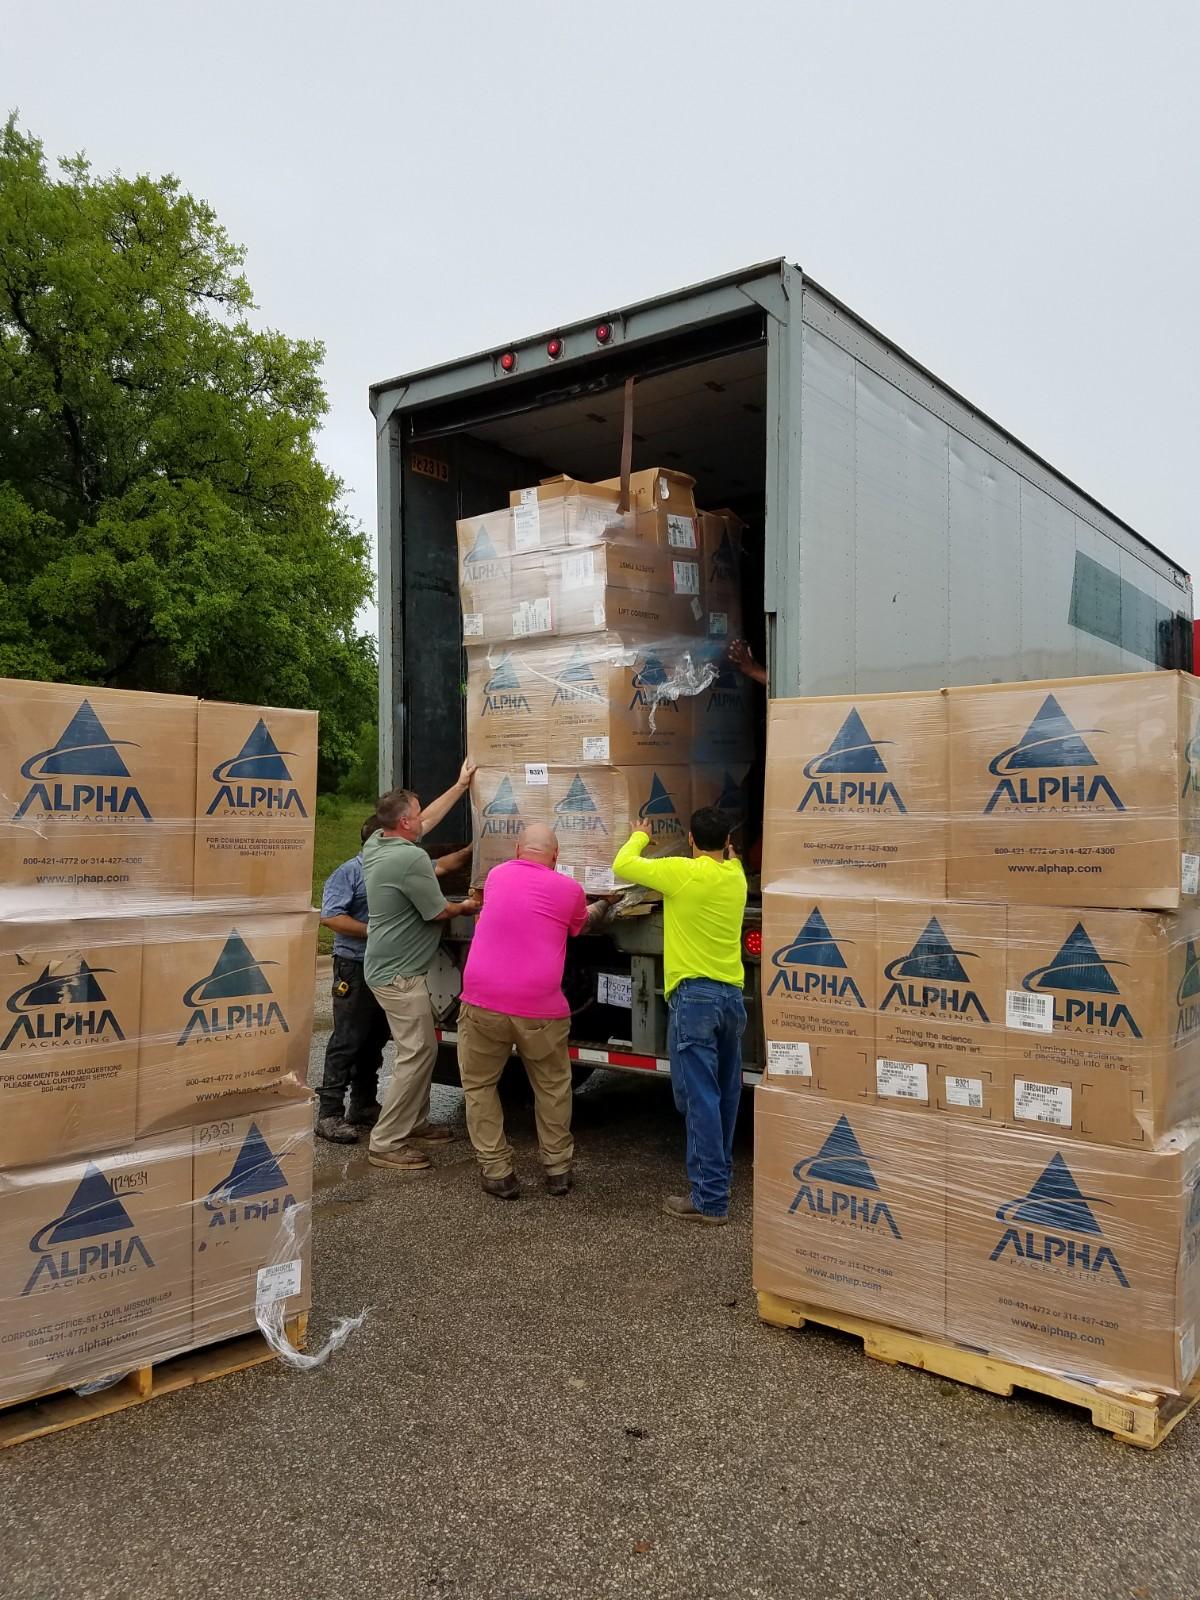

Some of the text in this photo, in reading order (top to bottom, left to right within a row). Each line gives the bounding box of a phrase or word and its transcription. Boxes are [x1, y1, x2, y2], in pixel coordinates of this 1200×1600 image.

[481, 694, 531, 716] ALPHA
[11, 784, 154, 822] ALPHA
[206, 785, 308, 818] ALPHA
[796, 782, 909, 814] ALPHA
[982, 775, 1127, 814] ALPHA
[36, 813, 136, 823] PACKAGING
[224, 809, 295, 817] PACKAGING
[813, 806, 892, 814] PACKAGING
[1004, 805, 1107, 814] PACKAGING
[650, 818, 685, 836] LPHA
[23, 857, 78, 865] 800-421-4772
[1008, 864, 1102, 874] www.alphap.com
[36, 873, 129, 885] www.alphap.com
[767, 970, 867, 1008] ALPHA
[781, 993, 852, 1006] PACKAGING
[879, 982, 991, 1023] ALPHA
[780, 1011, 849, 1027] Turning the science
[894, 1006, 975, 1022] PACKAGING
[1053, 996, 1143, 1039] LPHA
[0, 1009, 126, 1051] ALPHA
[176, 1001, 289, 1046] ALPHA
[772, 1018, 780, 1026] of
[781, 1020, 816, 1032] packaging
[818, 1024, 832, 1033] into
[1053, 1024, 1126, 1038] CKAGING
[20, 1036, 110, 1049] PACKAGING
[196, 1028, 276, 1044] PACKAGING
[895, 1027, 972, 1044] Turning the science
[938, 1040, 953, 1050] into
[1034, 1043, 1067, 1057] Turning
[1070, 1047, 1084, 1058] the
[1024, 1051, 1032, 1059] of
[1035, 1052, 1080, 1067] packaging
[1083, 1058, 1100, 1068] into
[3, 1080, 32, 1089] PLEASE
[33, 1078, 51, 1087] CALL
[52, 1074, 91, 1085] CUSTOMER
[16, 1071, 59, 1080] COMMENTS
[60, 1069, 75, 1077] AND
[186, 1073, 233, 1086] 800-421-4772
[955, 1078, 970, 1088] B321
[787, 1185, 903, 1240] ALPHA
[21, 1235, 155, 1296] ALPHA
[988, 1228, 1131, 1289] ALPHA
[42, 1265, 137, 1291] PACKAGING
[805, 1265, 882, 1291] www.alphap.com
[1, 1325, 53, 1344] CORPORATE
[1011, 1317, 1105, 1346] www.alphap.com
[46, 1329, 138, 1362] www.alphap.com
